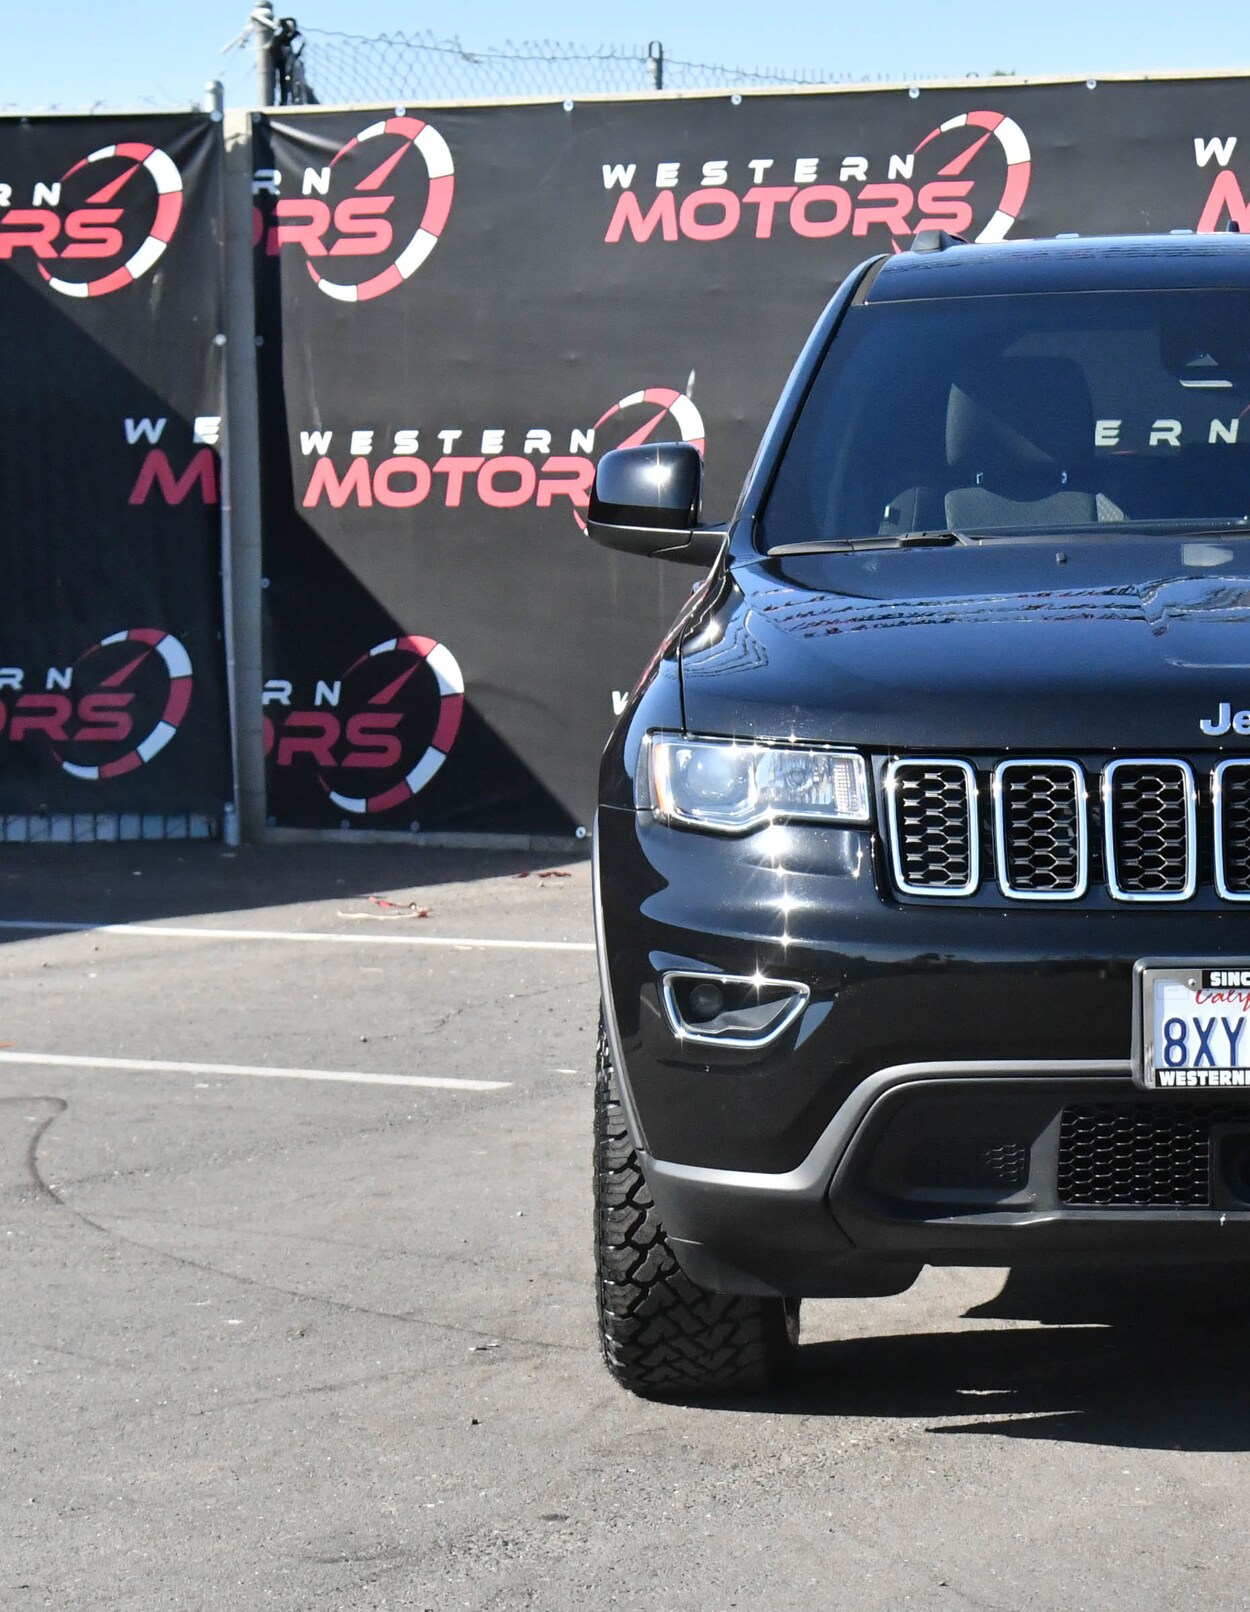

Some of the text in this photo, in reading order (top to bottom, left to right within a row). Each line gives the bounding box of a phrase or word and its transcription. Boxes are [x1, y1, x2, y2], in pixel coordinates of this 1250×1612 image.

[602, 154, 915, 189] WESTERN
[605, 181, 974, 243] MOTORS
[300, 429, 595, 455] WESTERN
